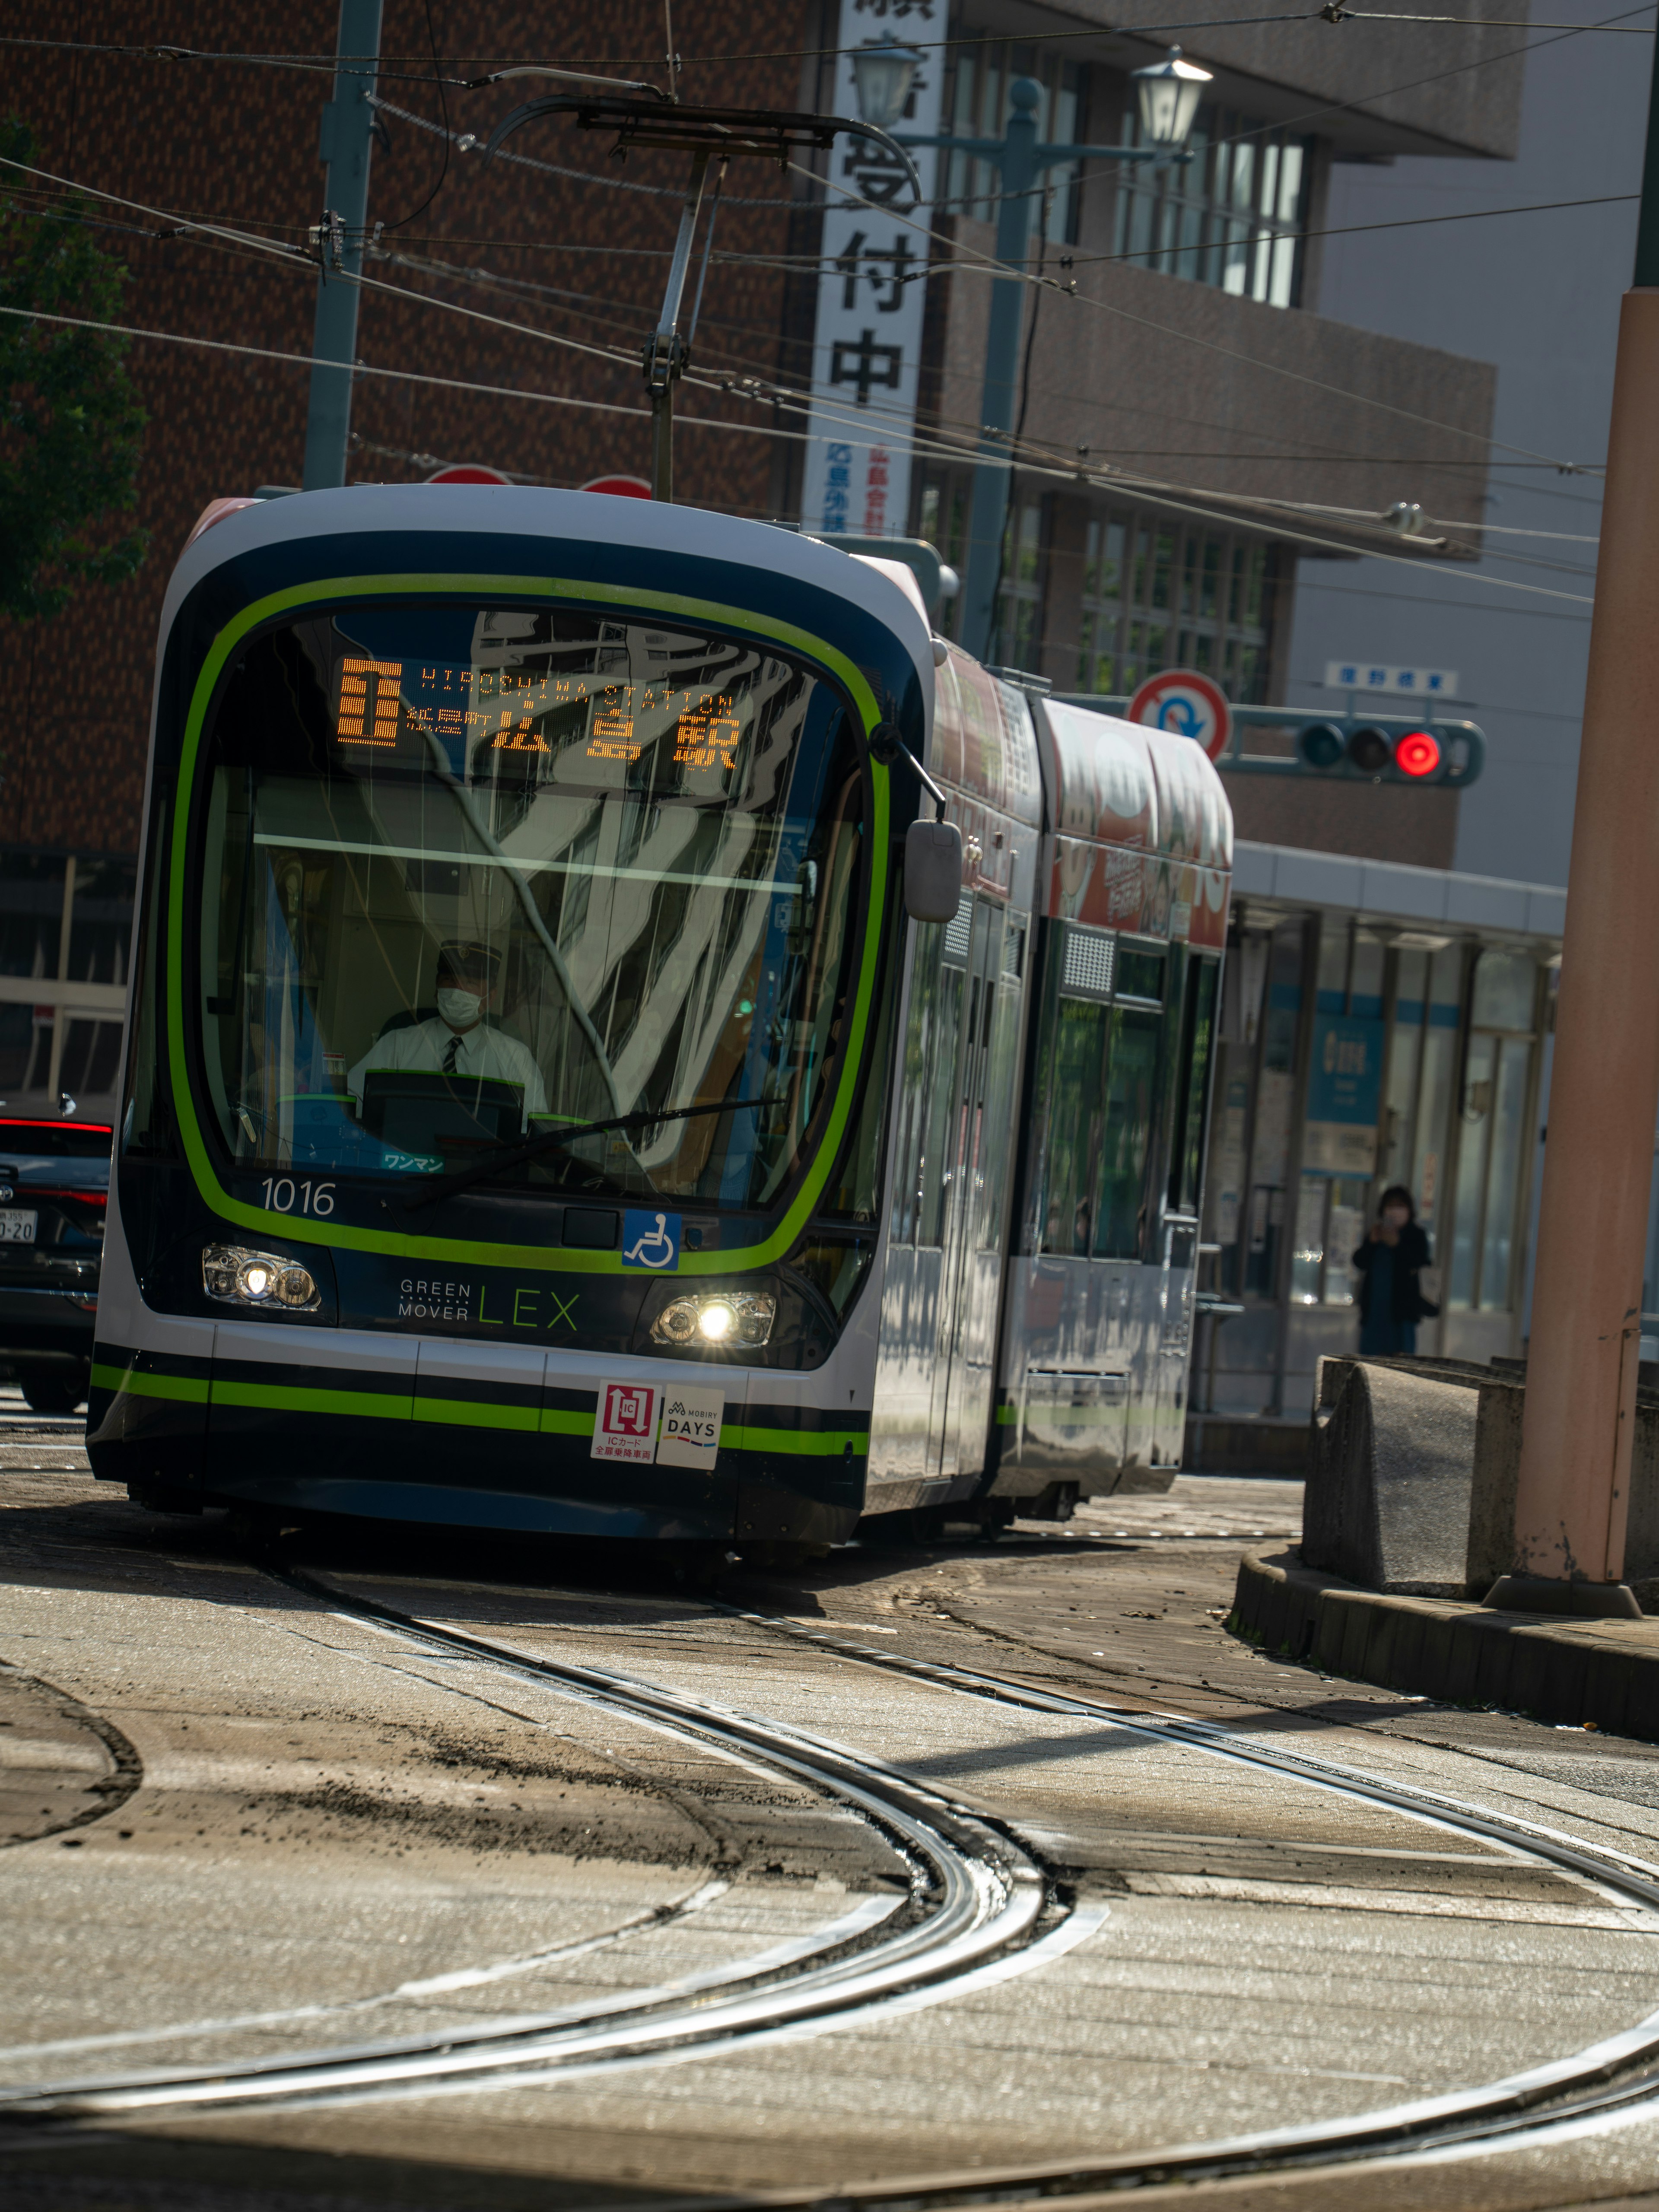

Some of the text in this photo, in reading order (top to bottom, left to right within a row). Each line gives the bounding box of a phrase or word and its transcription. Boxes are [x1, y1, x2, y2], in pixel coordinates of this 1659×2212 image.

[830, 0, 936, 404] 受付中
[864, 442, 892, 536] 広島会計
[422, 668, 732, 716] HIROSHIMA STATION
[385, 1154, 444, 1172] ワンマン
[262, 1177, 336, 1215] 1016
[401, 1279, 470, 1297] GREEN
[398, 1303, 468, 1321] MOVER
[479, 1285, 580, 1331] LEX
[624, 1404, 634, 1413] IC
[688, 1409, 718, 1420] MOBIRY
[667, 1419, 715, 1437] DAYS
[608, 1436, 642, 1448] ICカード
